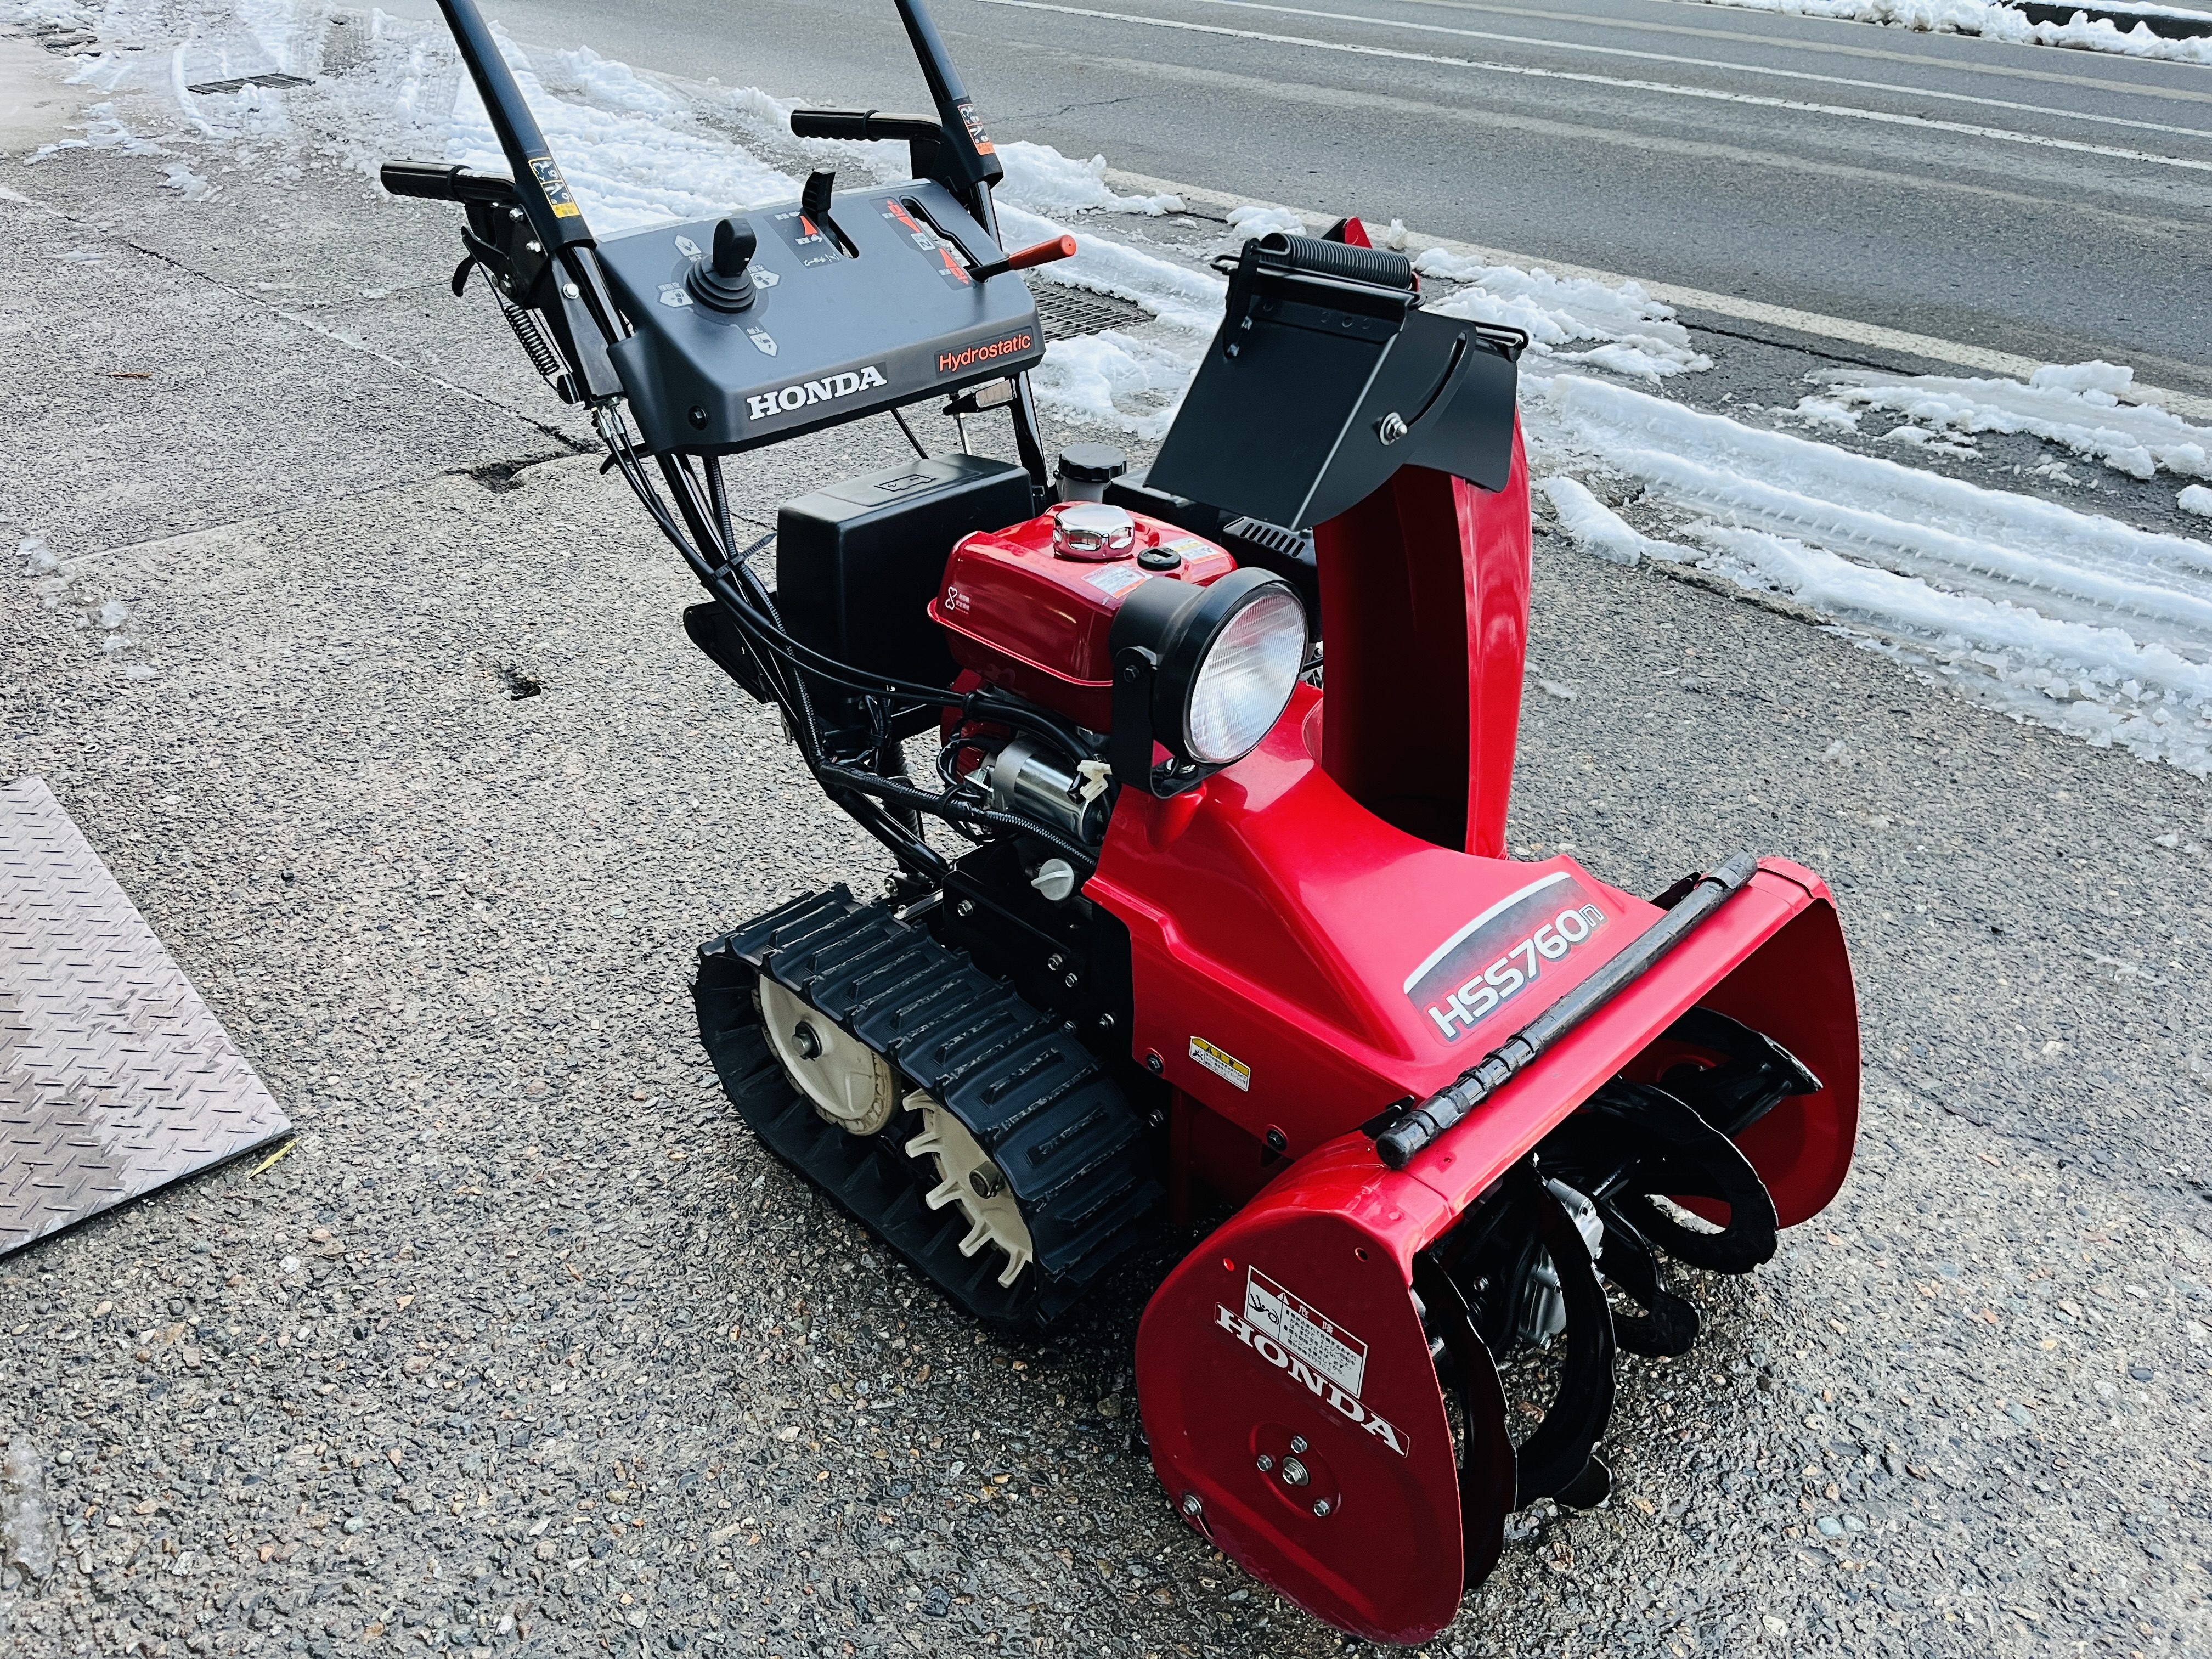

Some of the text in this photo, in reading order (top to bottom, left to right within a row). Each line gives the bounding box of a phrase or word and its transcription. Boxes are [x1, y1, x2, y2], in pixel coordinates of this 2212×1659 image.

[939, 334, 1031, 372] Hydrostatic
[746, 365, 887, 420] HONDA
[1298, 1305, 1333, 1335] 危険
[1216, 1304, 1404, 1457] HONDA
